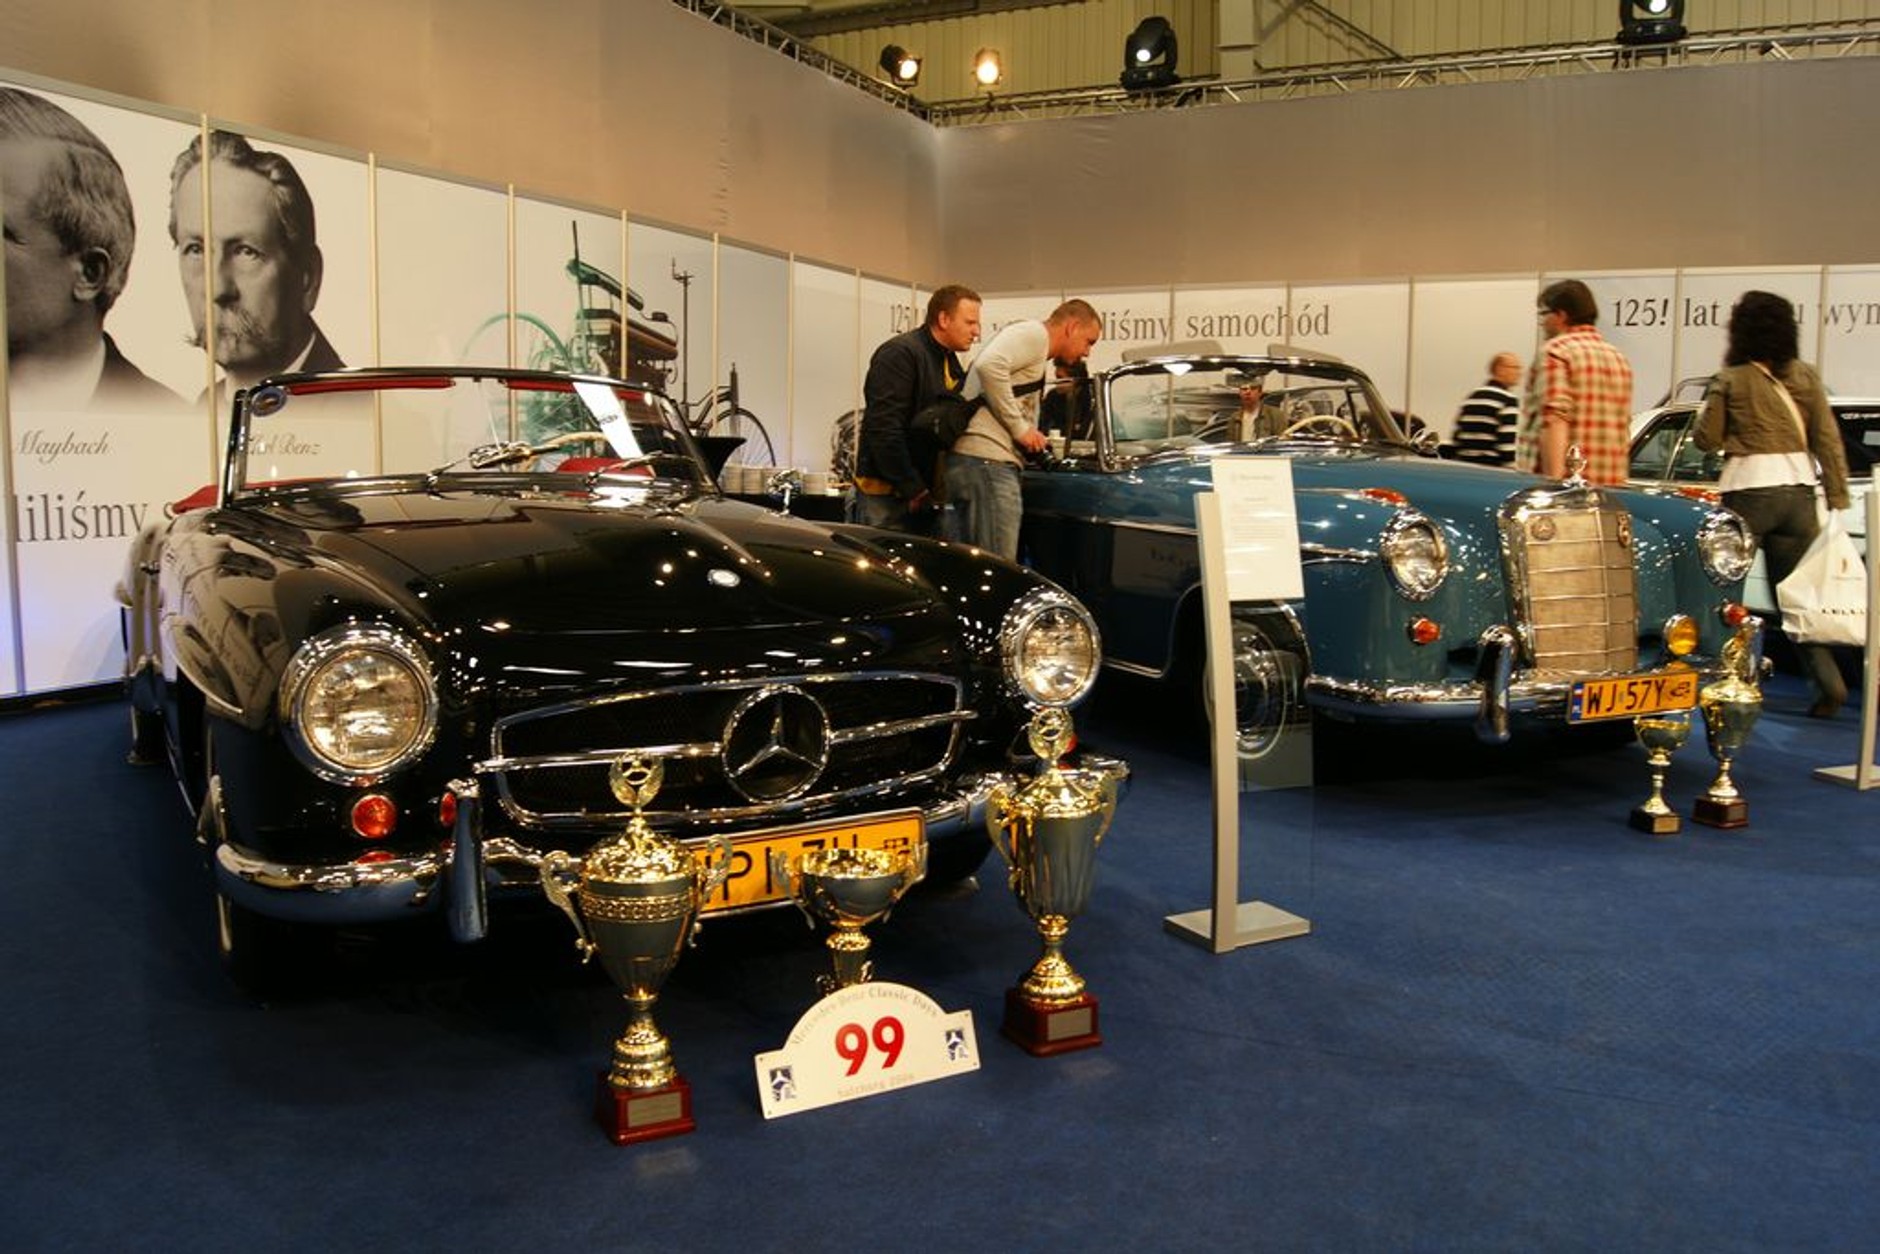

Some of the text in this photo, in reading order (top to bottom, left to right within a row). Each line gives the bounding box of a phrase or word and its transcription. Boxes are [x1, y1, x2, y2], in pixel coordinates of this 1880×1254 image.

[1187, 303, 1330, 338] samochód
[1612, 297, 1669, 328] 125!
[1684, 297, 1721, 328] lat
[18, 429, 111, 464] Maybach
[1587, 680, 1667, 714] WJ 57Y
[835, 1015, 905, 1078] 99
